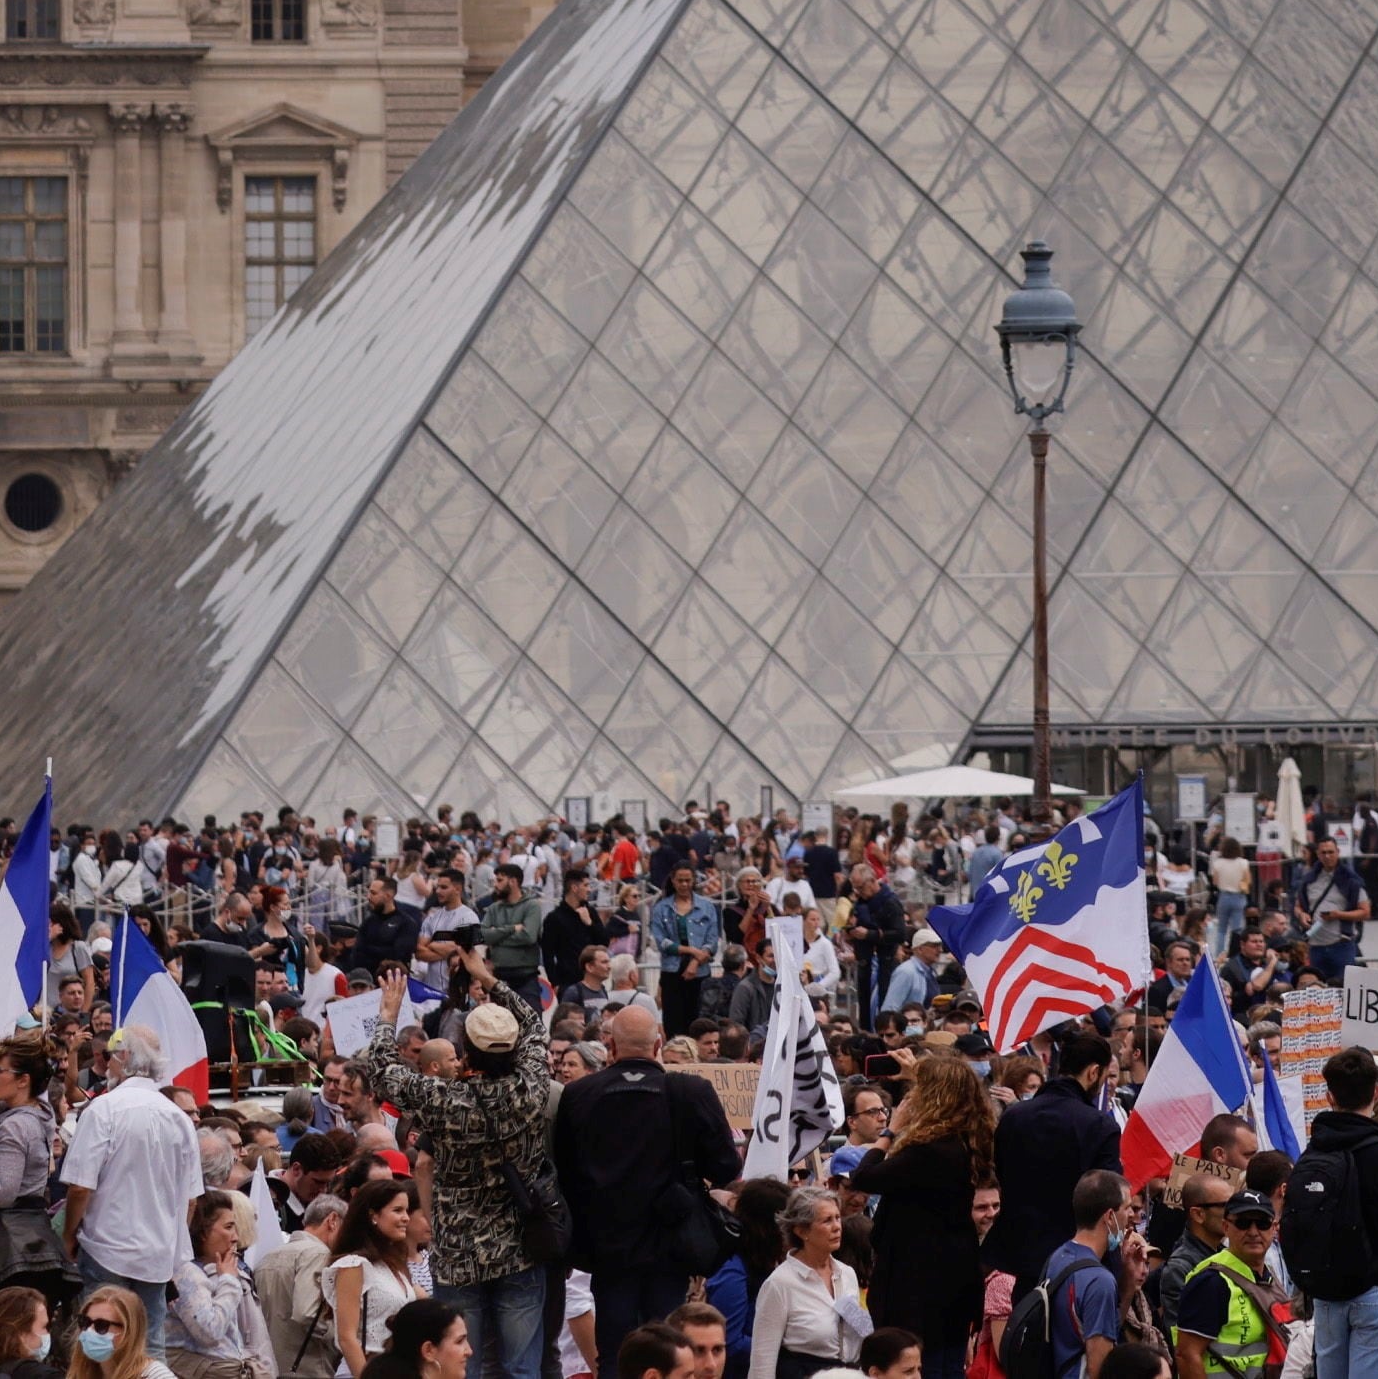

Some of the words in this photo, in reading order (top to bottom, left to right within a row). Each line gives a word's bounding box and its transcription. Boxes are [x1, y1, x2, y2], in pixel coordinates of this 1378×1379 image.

[1196, 727, 1238, 746] DU
[1174, 1153, 1187, 1167] LE
[1195, 1157, 1233, 1180] PASS
[1166, 1188, 1183, 1204] NO
